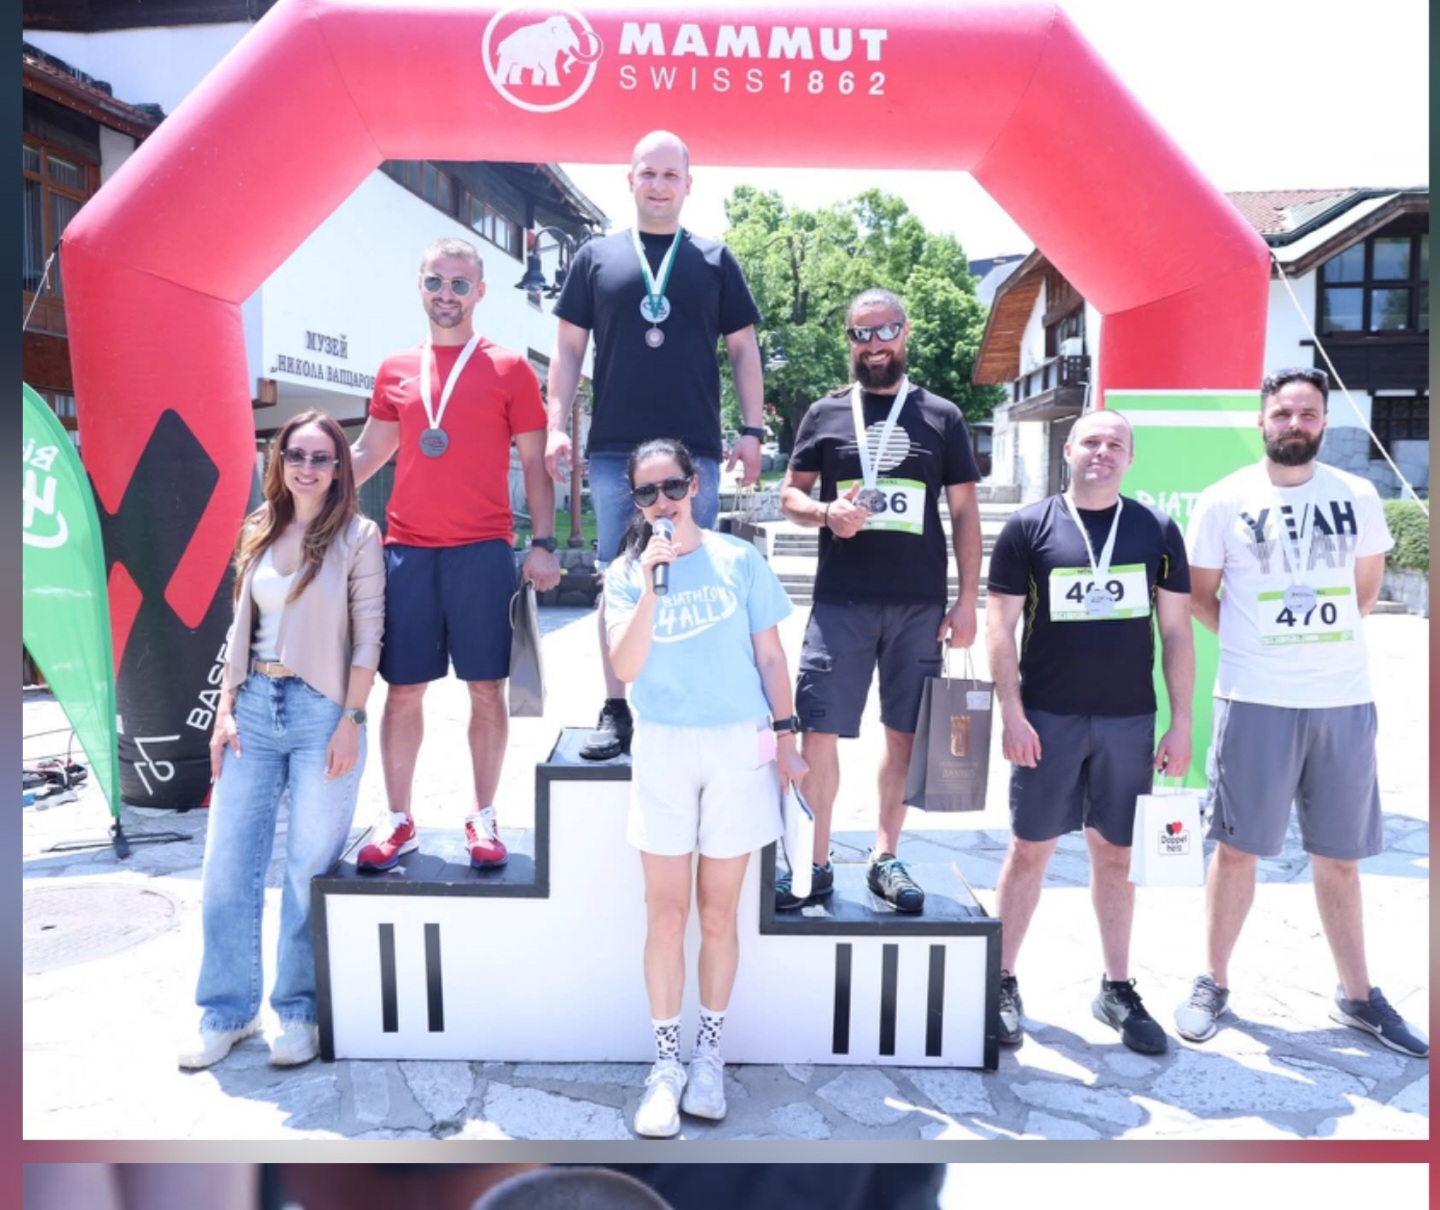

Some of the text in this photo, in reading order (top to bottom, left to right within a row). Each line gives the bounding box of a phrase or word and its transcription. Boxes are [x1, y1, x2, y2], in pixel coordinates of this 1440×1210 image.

[619, 22, 888, 62] MAMMUT
[306, 331, 348, 359] МУЗЕЙ
[1239, 500, 1358, 543] YEAH
